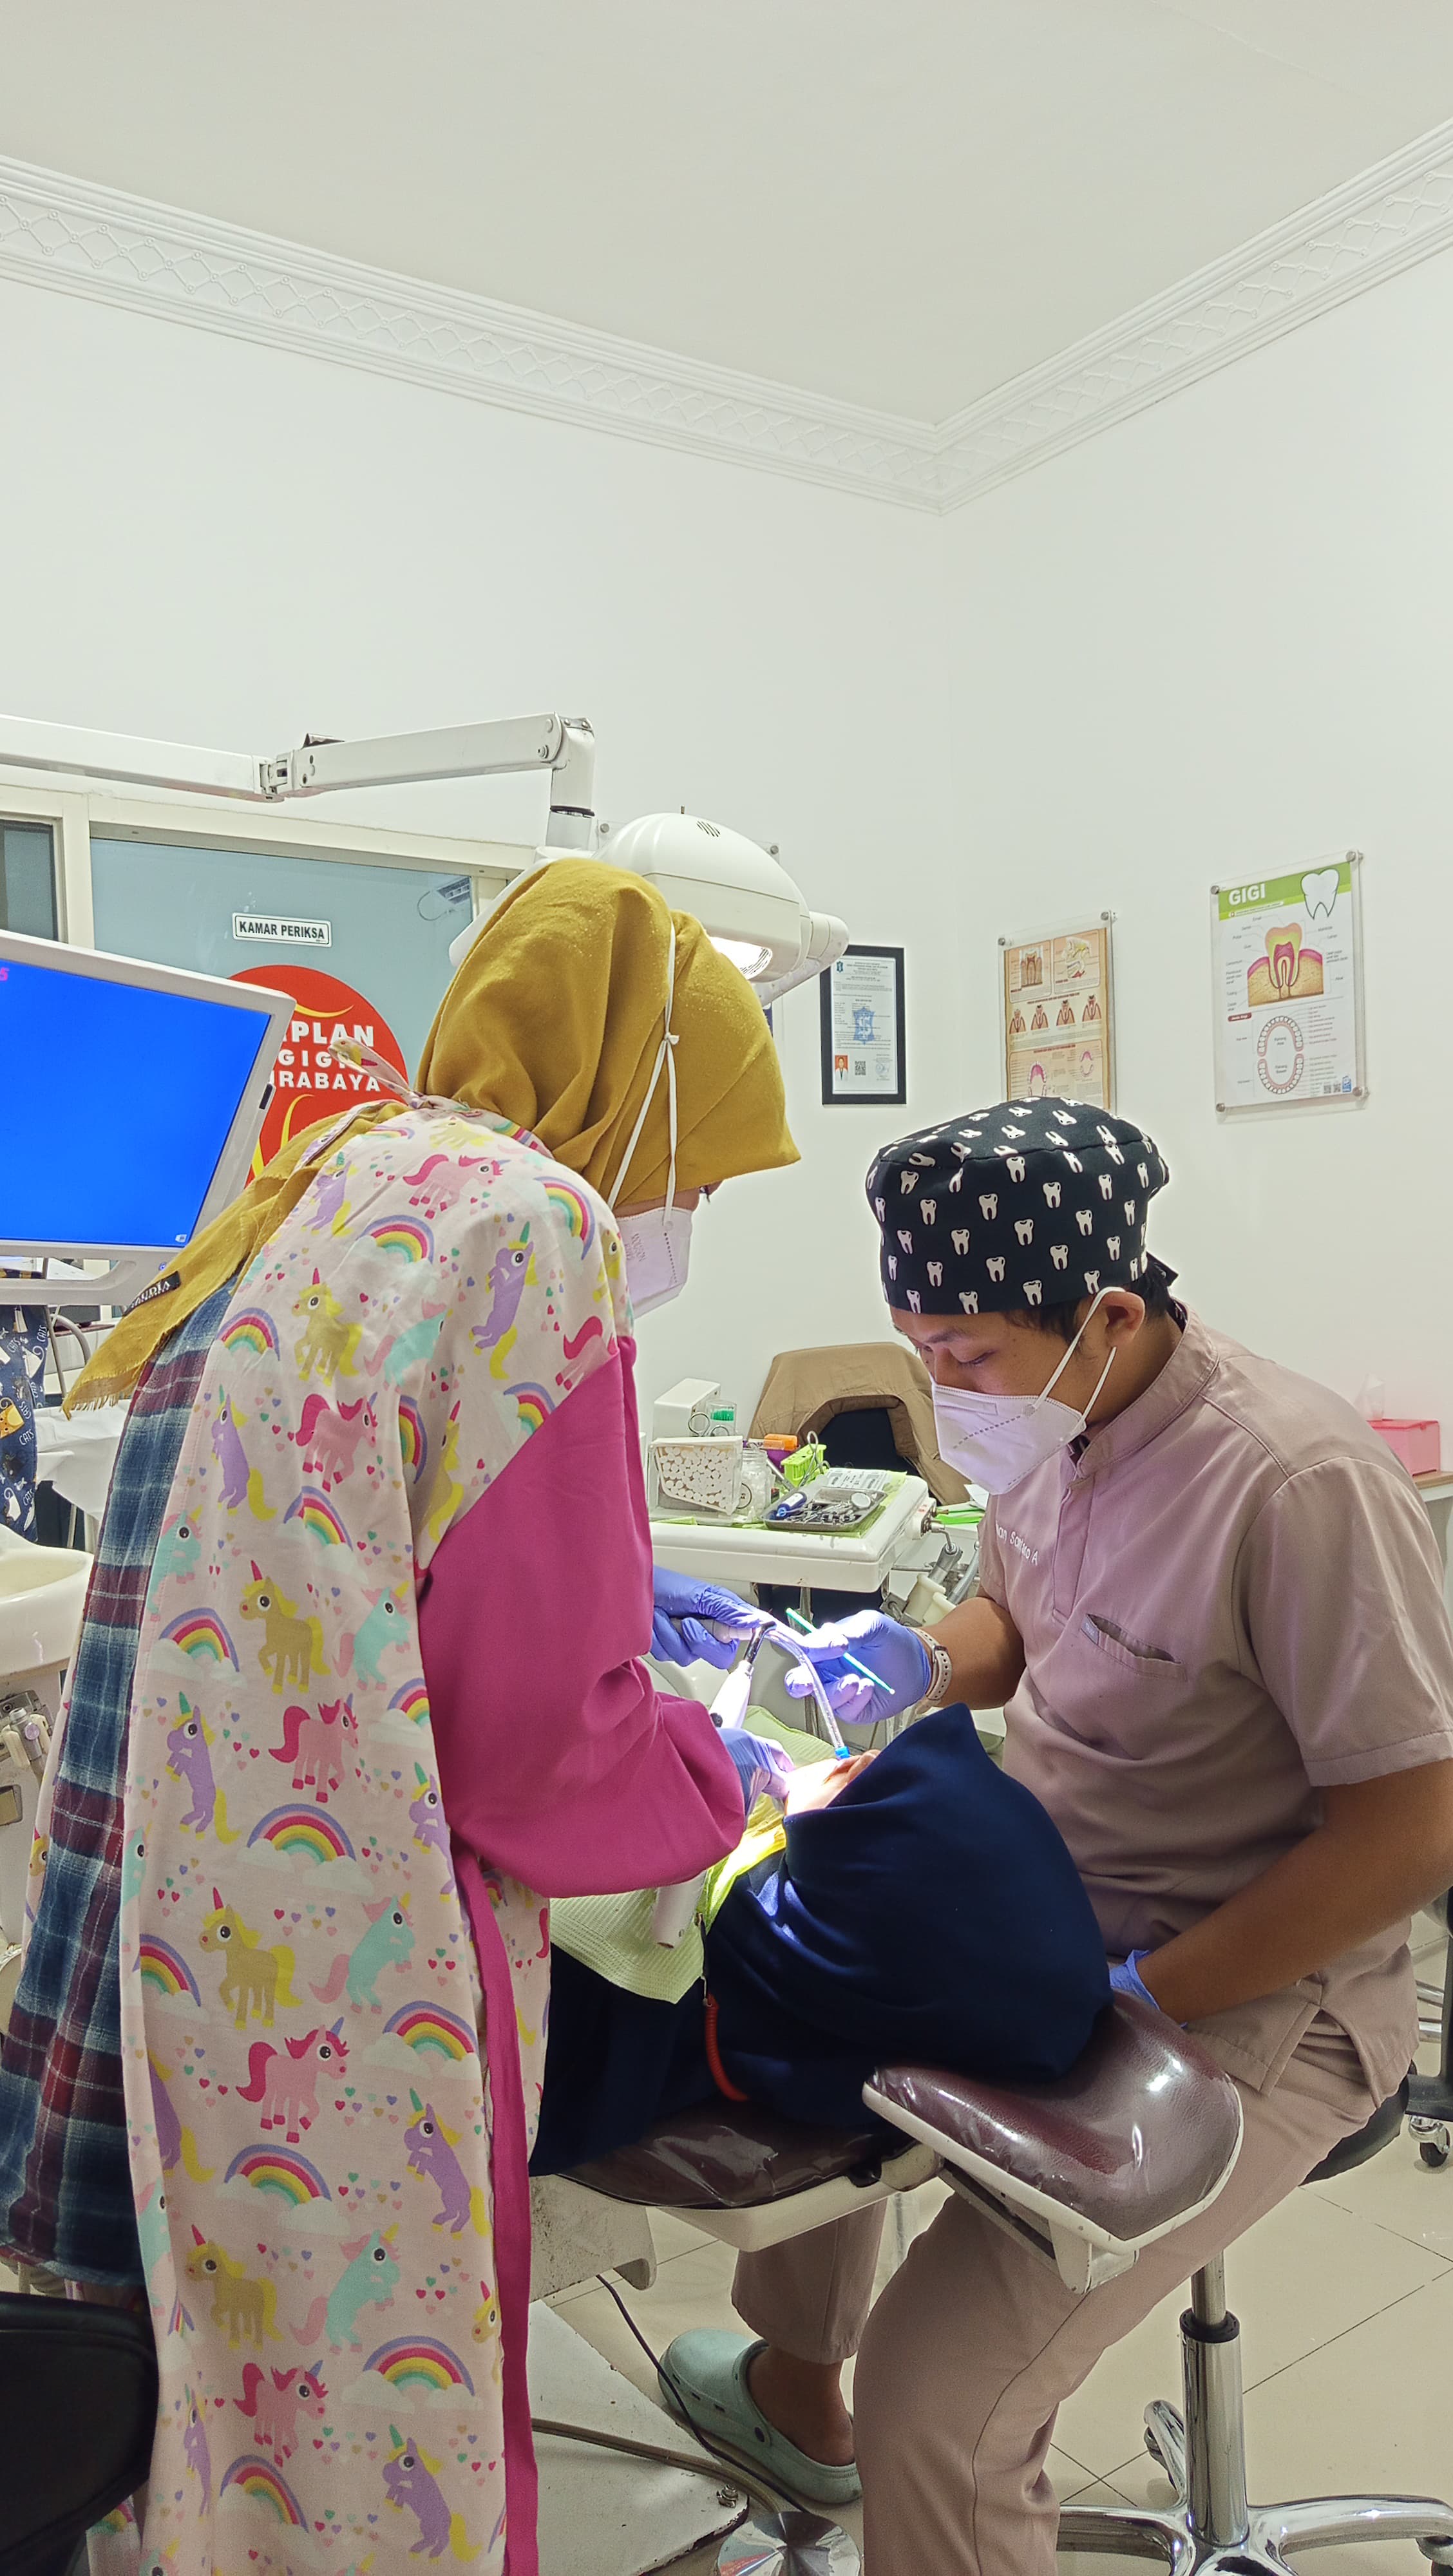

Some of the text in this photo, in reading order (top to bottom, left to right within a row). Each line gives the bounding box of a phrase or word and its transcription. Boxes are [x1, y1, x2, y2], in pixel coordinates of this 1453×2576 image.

[1229, 883, 1266, 905] GIGI
[239, 921, 325, 940] KAMAR PERIKSA
[283, 1020, 375, 1048] PLAN
[278, 1049, 346, 1069] GIG
[37, 1324, 48, 1342] CATS
[6, 1337, 21, 1352] CATS
[19, 1401, 32, 1419] CATS
[19, 1428, 34, 1446] CATS
[23, 1488, 34, 1506] CATS
[1031, 1550, 1038, 1566] A
